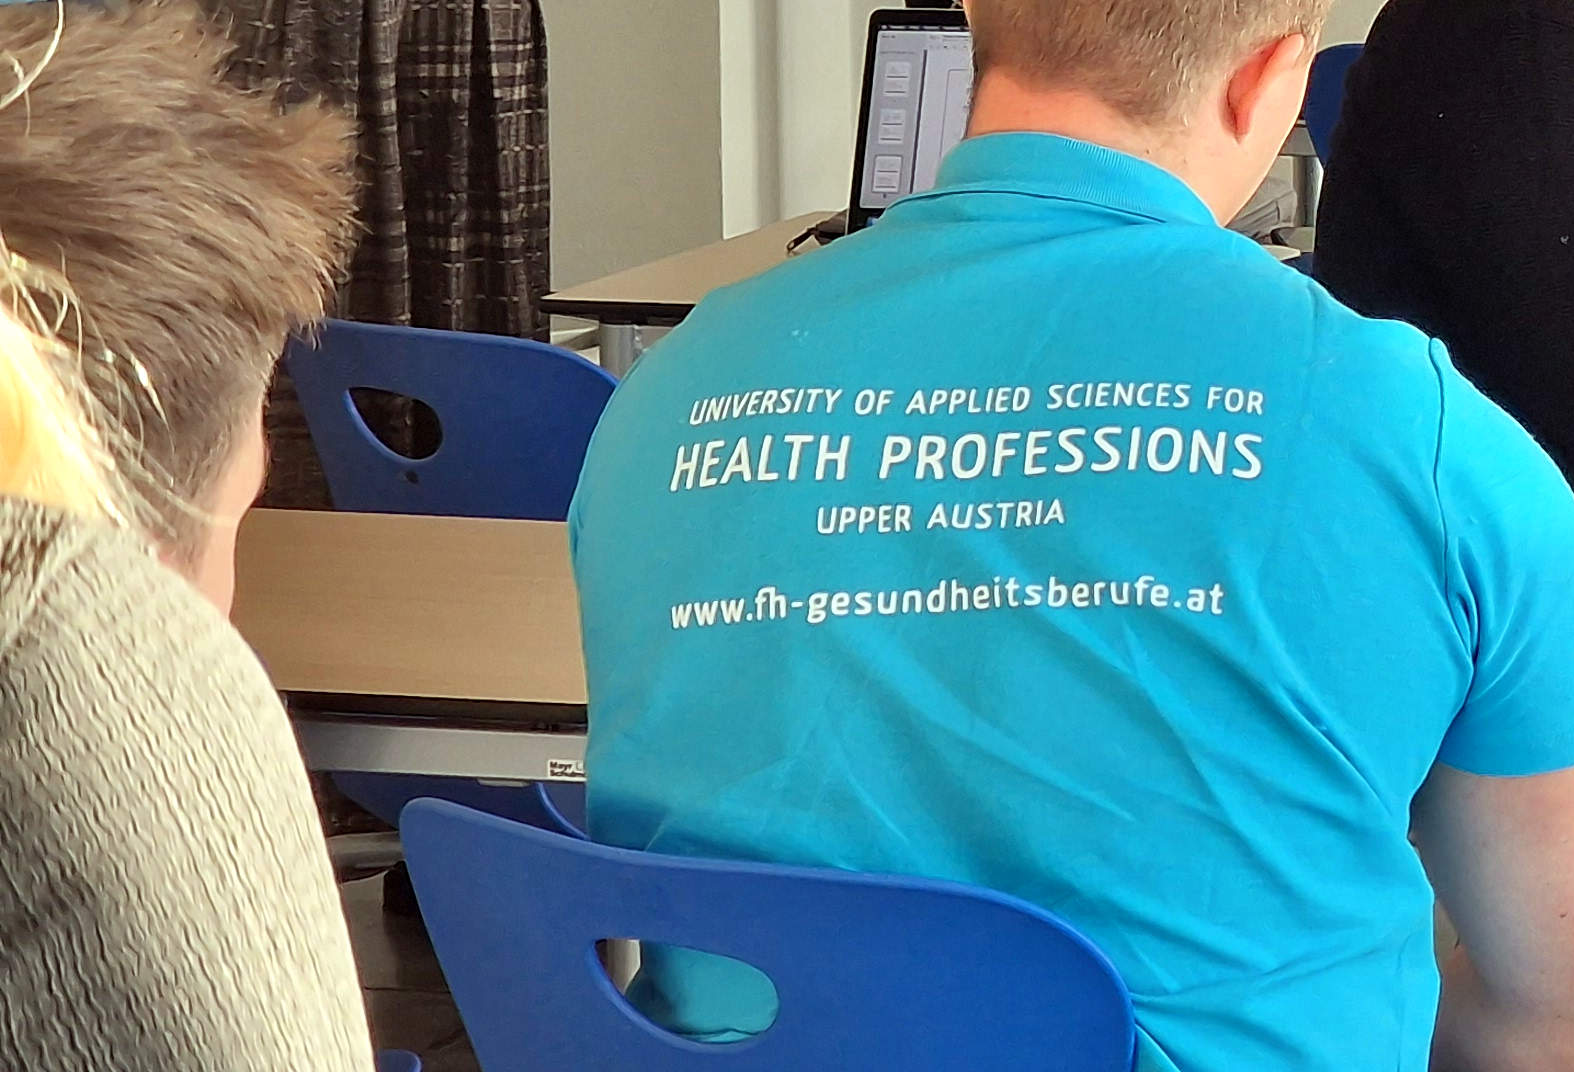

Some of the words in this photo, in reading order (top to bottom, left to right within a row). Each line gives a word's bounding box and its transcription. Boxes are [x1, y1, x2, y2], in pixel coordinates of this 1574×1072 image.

[690, 387, 842, 426] UNIVERSITY
[854, 389, 895, 416] OF
[905, 385, 1031, 416] APPLIED
[1046, 382, 1192, 410] SCIENCES
[1207, 386, 1265, 415] FOR
[668, 434, 850, 493] HEALTH
[879, 426, 1264, 482] PROFESSIONS
[816, 504, 911, 534] UPPER
[926, 498, 1066, 530] AUSTRIA
[670, 574, 1224, 630] www.fh-gesundheitsberufe.at
